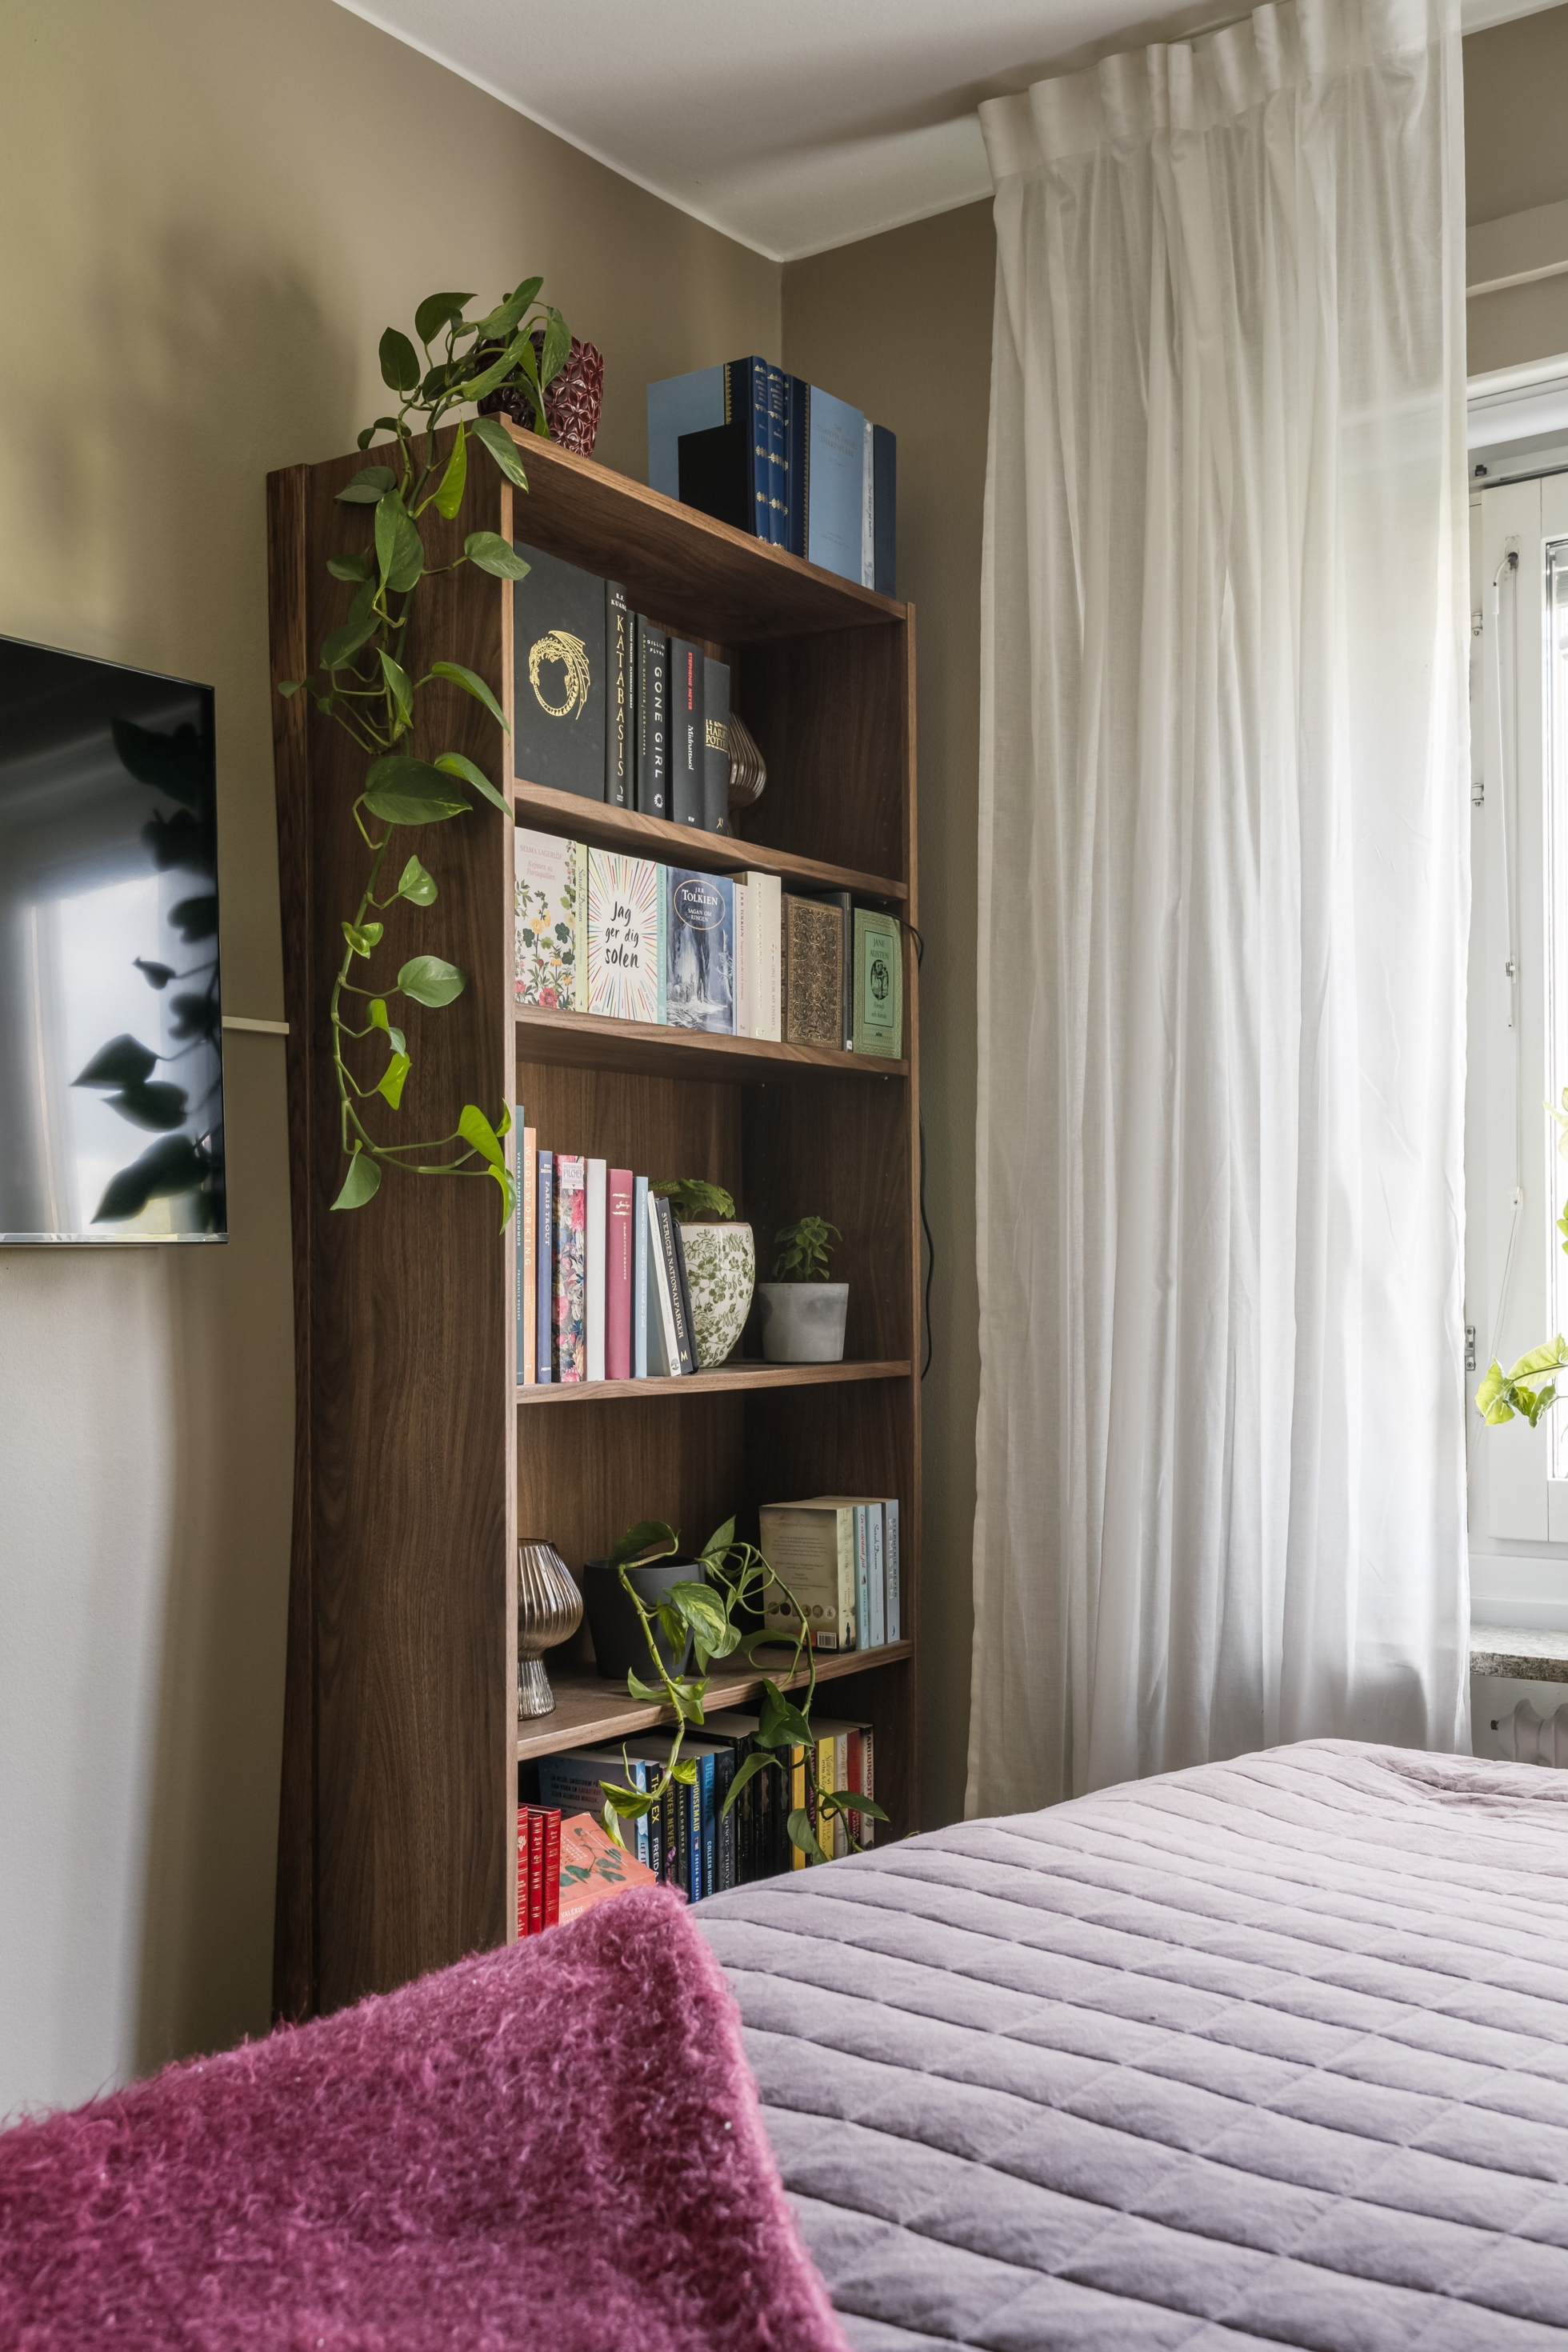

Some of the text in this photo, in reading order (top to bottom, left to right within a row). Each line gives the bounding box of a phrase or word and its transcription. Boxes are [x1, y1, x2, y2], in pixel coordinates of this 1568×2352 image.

[816, 424, 859, 450] COMPLETE OXFORD
[833, 423, 842, 434] THE
[820, 435, 854, 458] SHAKESPEARE
[616, 614, 625, 777] KATABASIS
[654, 666, 663, 779] GONE GIRL
[520, 845, 563, 860] SELMA LAGERLÖF
[526, 868, 556, 881] Portugallien
[527, 860, 546, 870] Kejsarn
[578, 866, 586, 892] Sarah
[578, 892, 586, 922] Dessen
[682, 889, 718, 906] TOLKIEN
[610, 901, 631, 926] Jag
[690, 914, 709, 922] RINGEN
[605, 927, 639, 948] ger dig
[873, 938, 886, 948] JANE
[605, 942, 640, 969] solen
[870, 950, 889, 960] AUSTEN
[646, 993, 655, 1013] NELSON
[770, 994, 776, 1005] MY
[563, 1169, 582, 1178] PILCHER
[661, 1212, 684, 1339] SVERIGES NATIONALPARKER
[860, 1514, 865, 1524] En
[569, 1778, 592, 1786] SNÖSTORM
[593, 1780, 599, 1788] PÅ
[865, 1753, 873, 1798] JUNGSTE
[562, 1792, 581, 1801] ALLDELES
[666, 1784, 674, 1815] NEVER
[705, 1762, 713, 1821] UGLY LOVE
[651, 1805, 660, 1824] EX
[693, 1782, 701, 1833] HOUSEMAID
[560, 1905, 584, 1918] VALÉRIE
